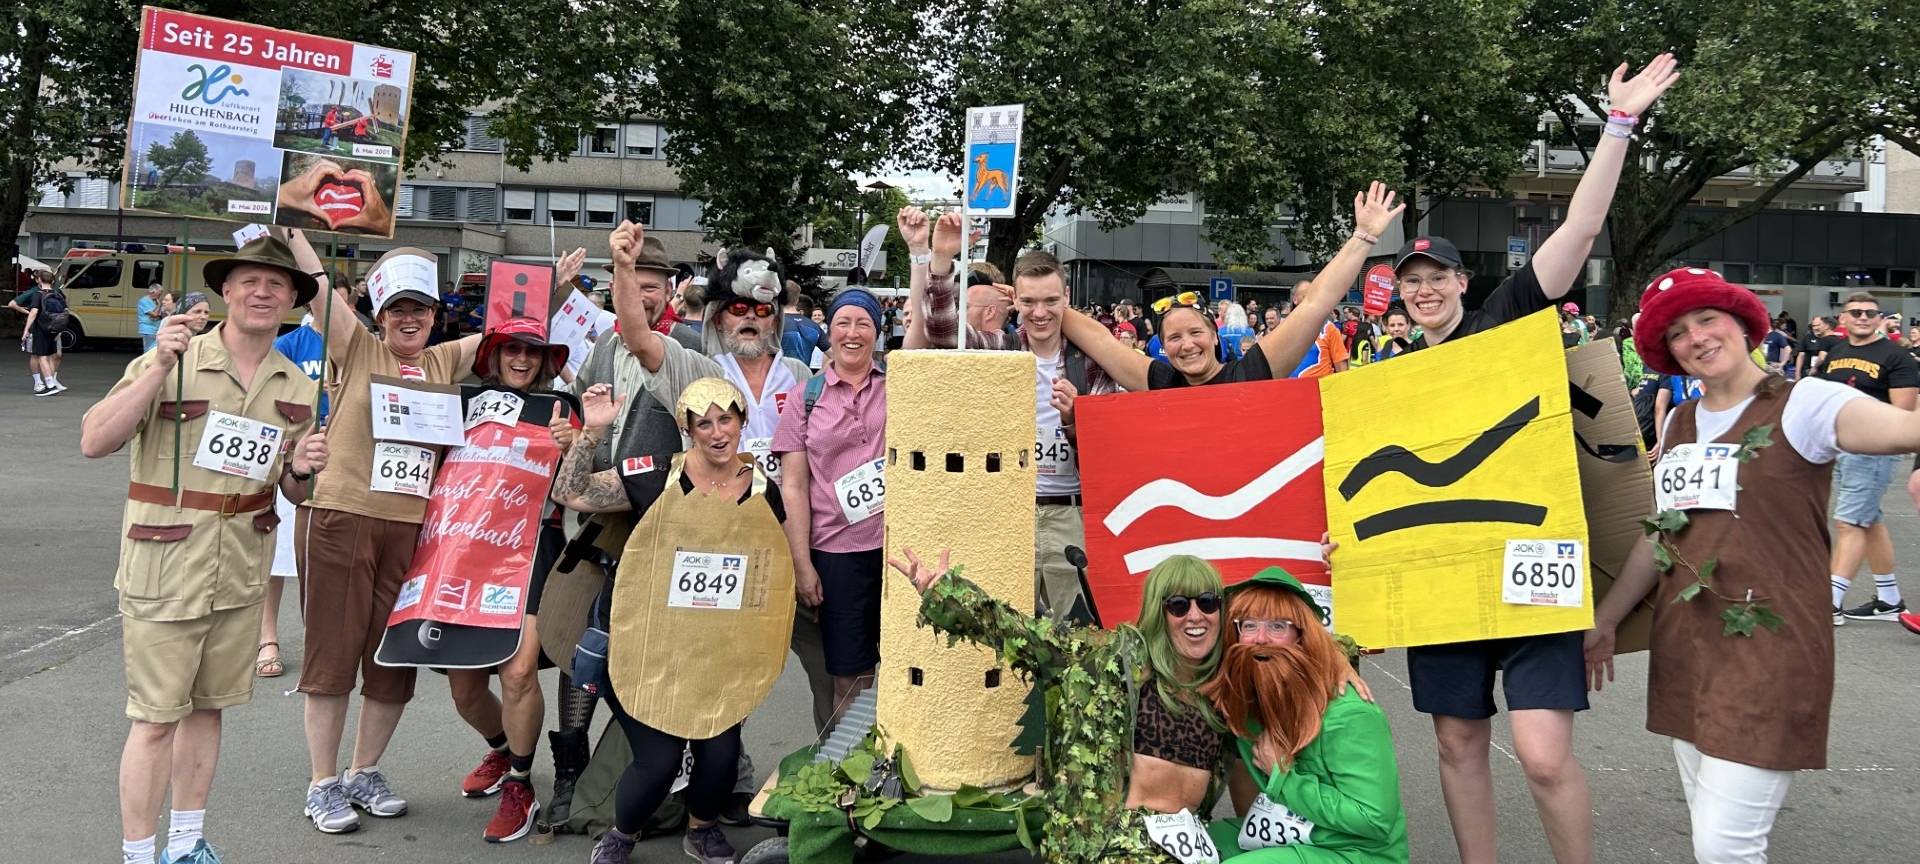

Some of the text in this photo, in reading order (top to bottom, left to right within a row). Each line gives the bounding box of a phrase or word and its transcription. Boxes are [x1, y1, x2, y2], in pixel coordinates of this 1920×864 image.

[163, 23, 340, 70] Seit 25 Jahren
[169, 102, 260, 124] HILCHENBACH
[1215, 281, 1228, 299] P
[217, 417, 239, 428] AOK
[469, 400, 515, 422] 6847
[208, 433, 271, 465] 6838
[383, 446, 402, 454] AOK
[1035, 442, 1069, 462] 845
[380, 460, 430, 484] 6844
[1661, 464, 1721, 494] 6841
[846, 477, 886, 508] 683
[1513, 543, 1534, 553] AOK
[682, 556, 701, 565] AOK
[678, 571, 738, 595] 6849
[1512, 561, 1576, 589] 6850
[1155, 815, 1176, 824] AOK
[1245, 813, 1304, 845] 6833
[1161, 831, 1213, 857] 6848
